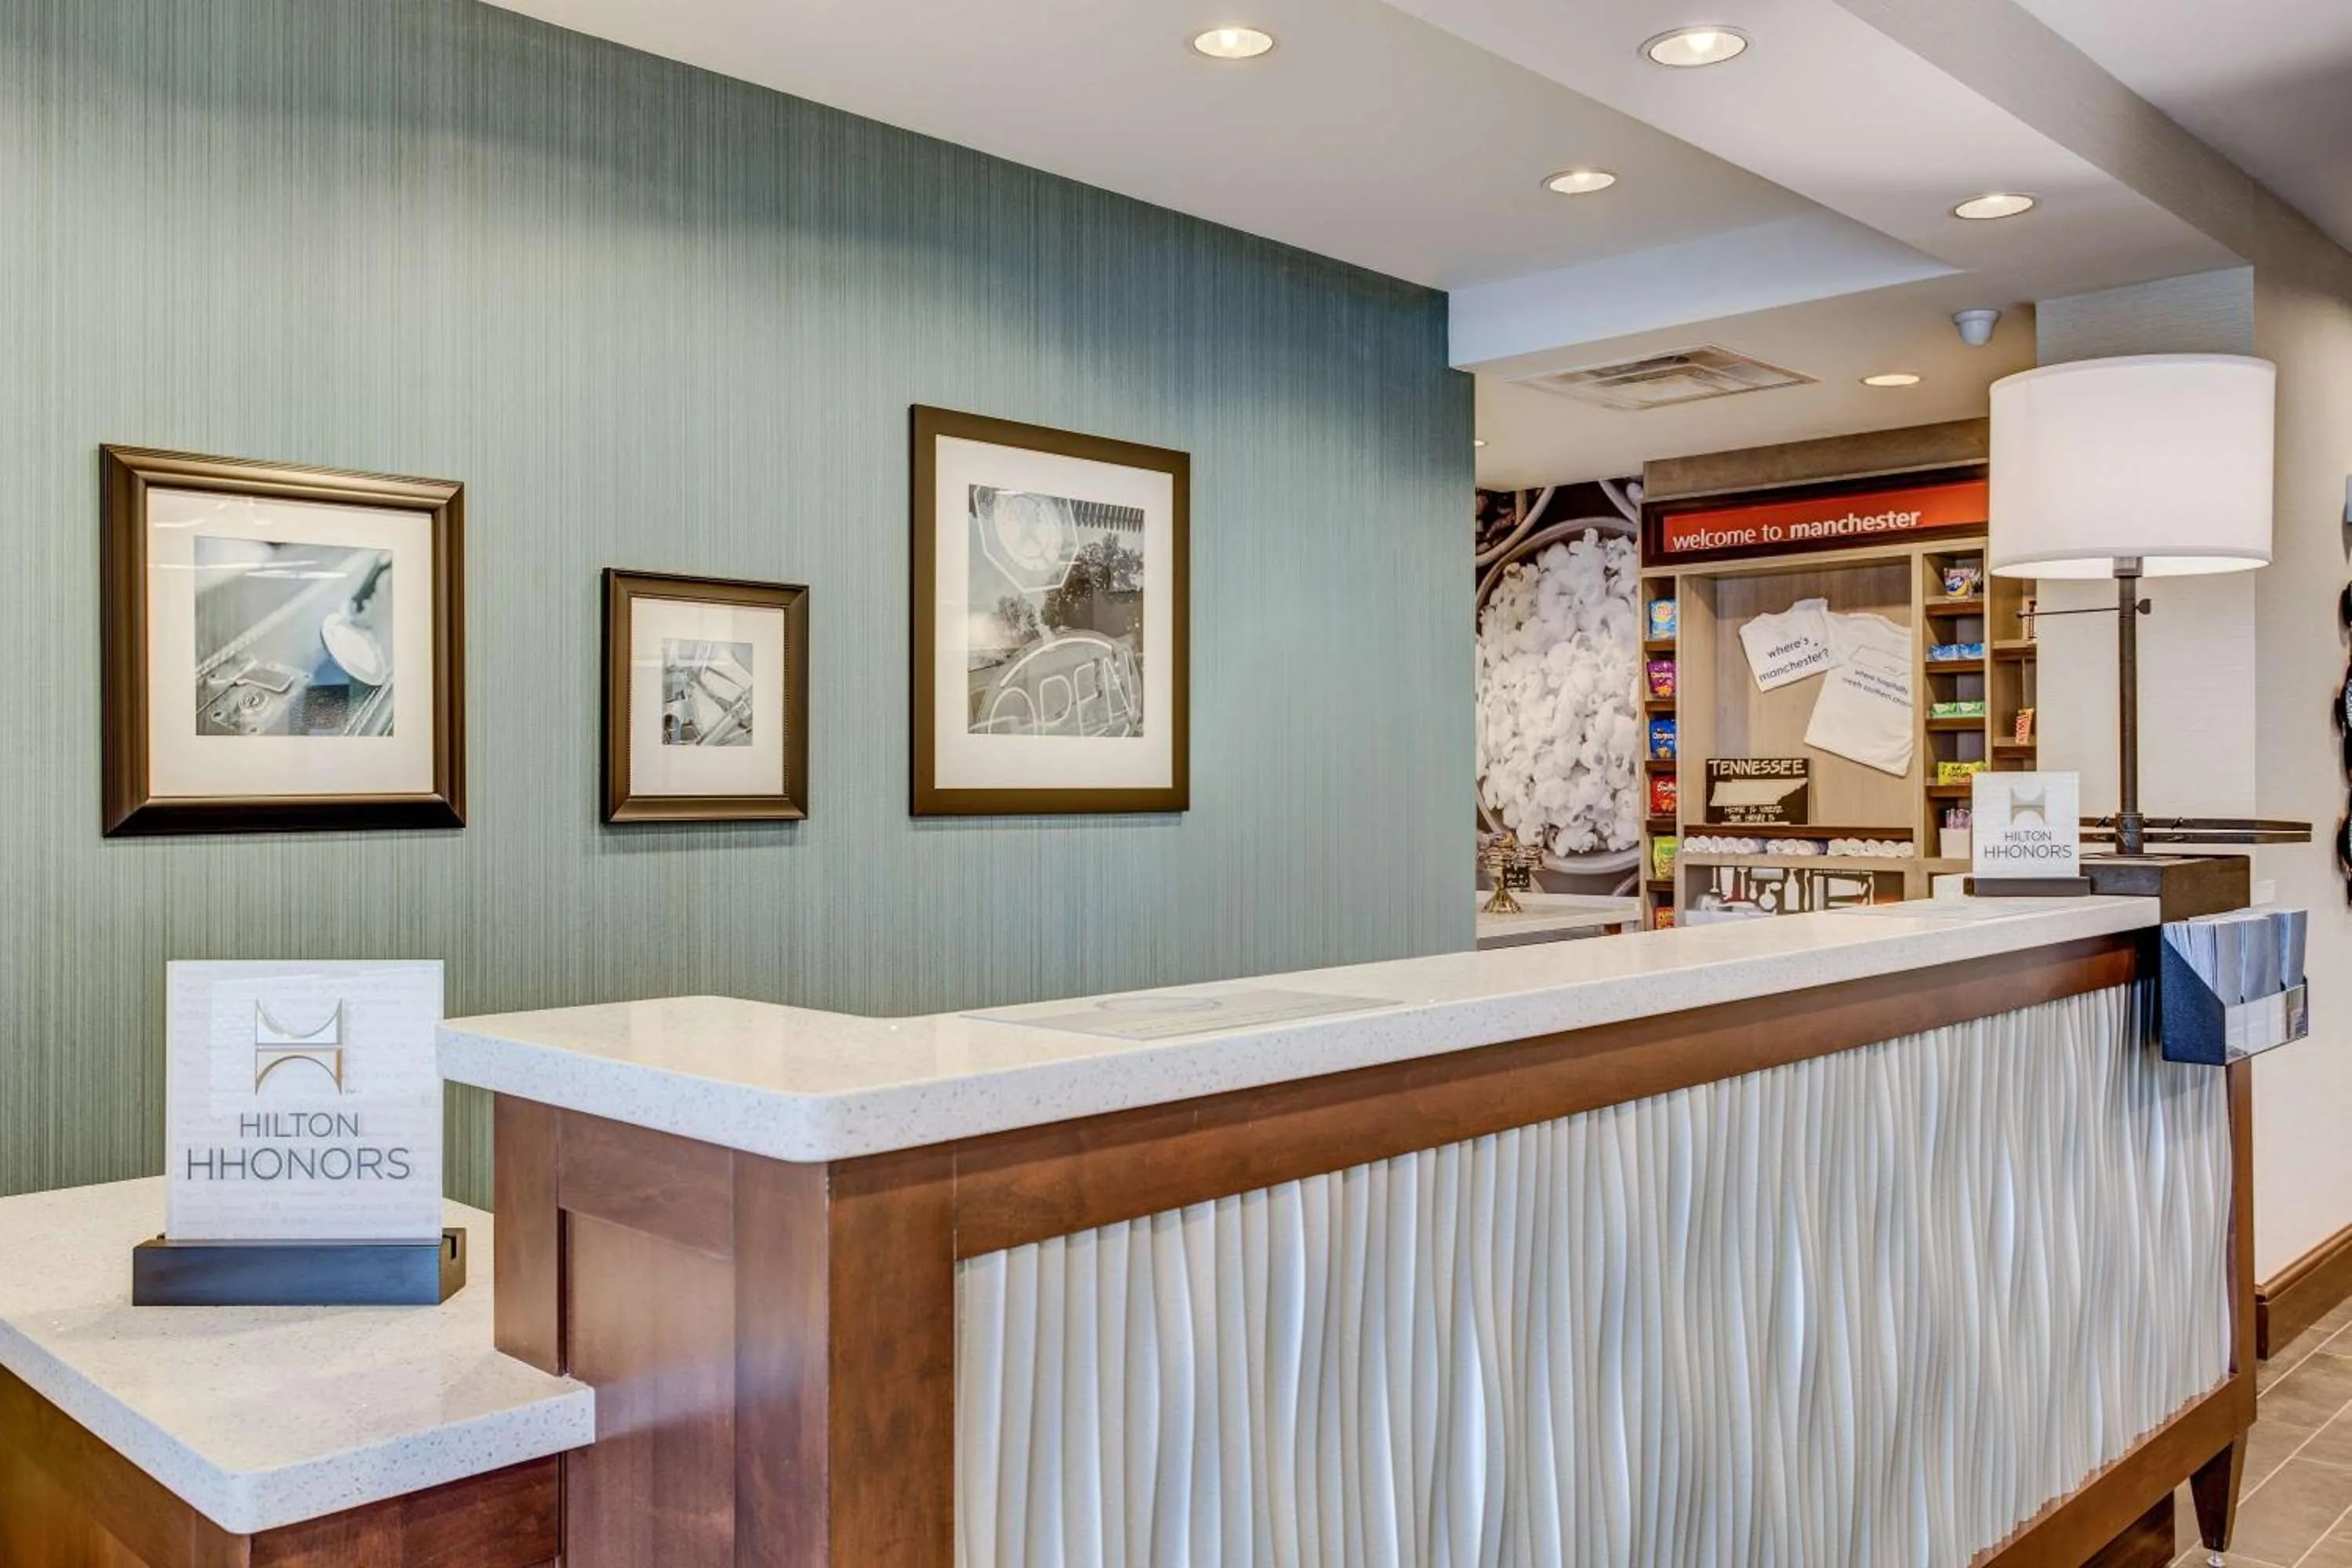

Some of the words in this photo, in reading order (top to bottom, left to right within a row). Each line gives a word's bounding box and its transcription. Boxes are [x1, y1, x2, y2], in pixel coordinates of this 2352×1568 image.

[1672, 528, 1757, 550] welcome
[1761, 524, 1783, 542] to
[1789, 510, 1922, 539] manchester
[1708, 760, 1806, 775] TENNESSEE
[2004, 830, 2053, 842] HILTON
[1984, 844, 2073, 859] HHONORS
[240, 1112, 359, 1138] HILTON
[187, 1147, 411, 1180] HHONORS
